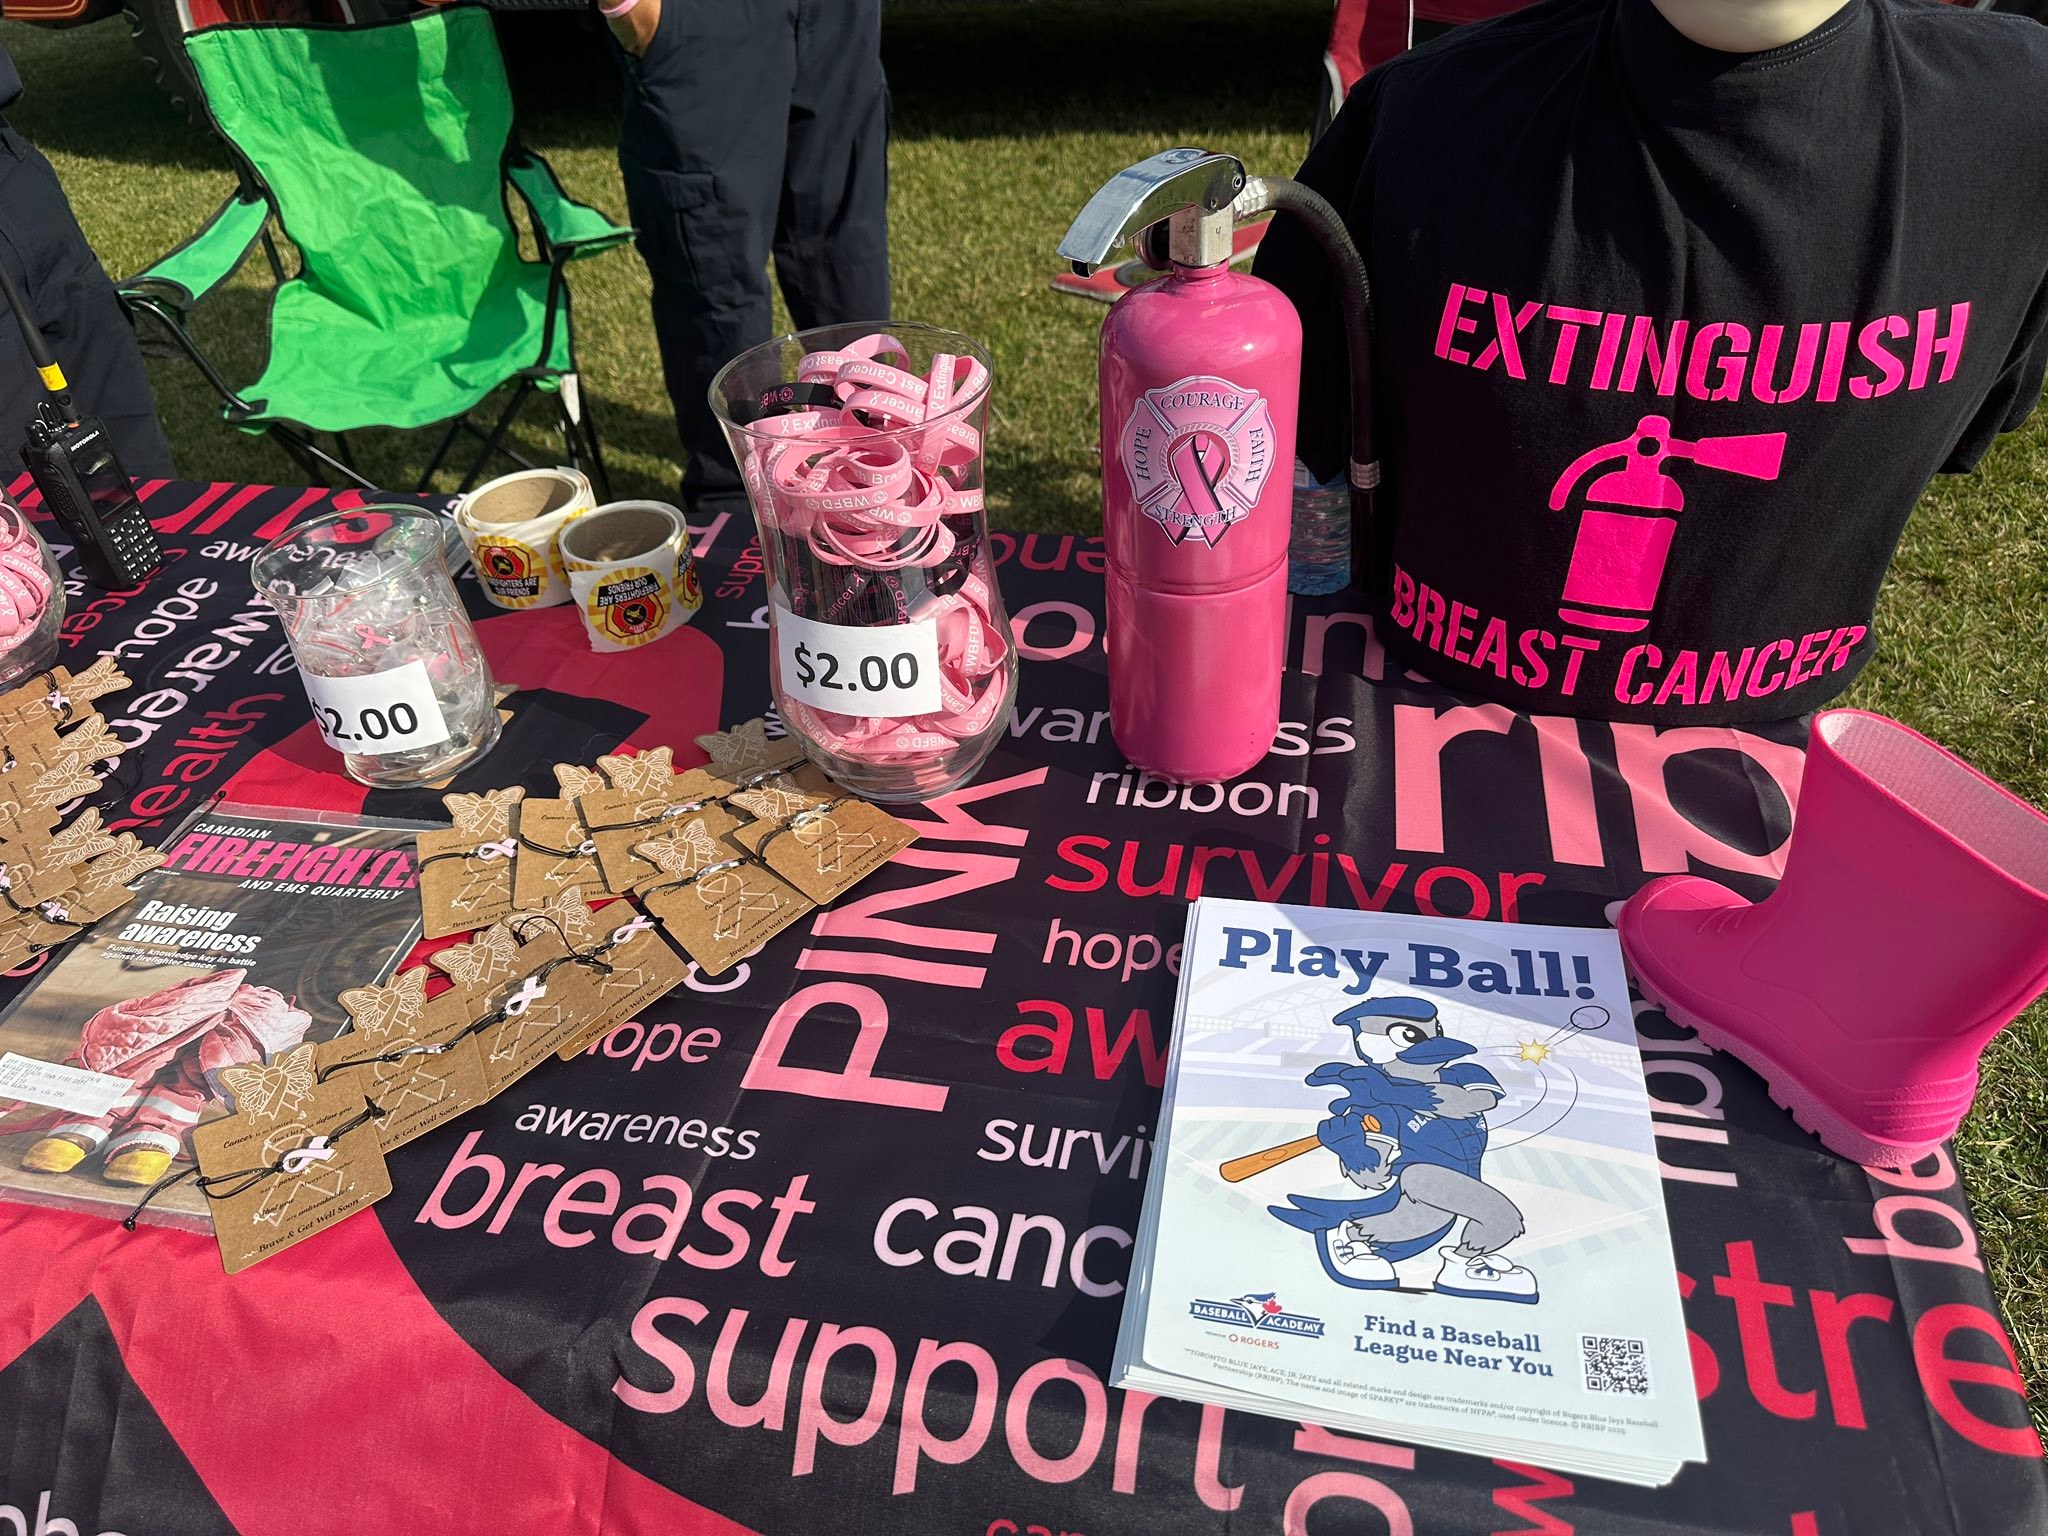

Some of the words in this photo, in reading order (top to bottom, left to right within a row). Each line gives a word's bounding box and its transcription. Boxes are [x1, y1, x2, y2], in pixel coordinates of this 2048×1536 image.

[1433, 282, 1971, 403] EXTINGUISH
[1161, 392, 1244, 411] COURAGE
[71, 430, 100, 452] MOTOROLA
[1133, 425, 1152, 484] HOPE
[1245, 426, 1266, 486] FAITH
[823, 494, 869, 510] WBFD
[1154, 504, 1237, 528] STRENGTH
[507, 587, 530, 597] FRIENDS
[524, 577, 538, 587] ARE
[599, 595, 613, 606] ARE
[607, 580, 634, 595] FRIENDS
[614, 581, 659, 603] FIREFIGHTERS
[633, 576, 648, 588] OUR
[966, 622, 983, 668] WBFD
[1390, 562, 1602, 696] BREAST
[1614, 624, 1867, 705] CANCER
[794, 641, 920, 693] $2.00
[312, 697, 418, 740] $2.00
[1086, 765, 1320, 819] ribbon
[192, 823, 272, 839] CANADIAN
[237, 879, 274, 891] AND
[277, 883, 310, 895] EMS
[312, 885, 404, 900] QUARTERLY
[1044, 834, 1546, 922] survivor
[135, 900, 238, 931] Raising
[769, 918, 784, 931] Well
[784, 907, 800, 920] Soon
[107, 944, 145, 955] Funding,
[149, 949, 198, 961] knowledge
[199, 954, 216, 963] key
[218, 956, 228, 964] in
[229, 958, 257, 967] battle
[118, 923, 262, 955] awareness
[741, 766, 1050, 1114] PINK
[101, 952, 134, 961] against
[136, 953, 183, 966] firefighter
[184, 962, 217, 970] cancer
[1218, 926, 1389, 996] Play
[1408, 943, 1596, 1000] Ball!
[585, 1025, 607, 1041] Brave
[615, 1008, 629, 1020] Get
[630, 996, 646, 1010] Well
[647, 984, 664, 998] Soon
[530, 1048, 544, 1060] Get
[545, 1035, 562, 1049] Well
[563, 1022, 580, 1036] Soon
[587, 1020, 721, 1071] ope
[402, 1124, 418, 1138] Get
[419, 1113, 437, 1128] Well
[439, 1104, 459, 1118] Soon
[515, 1103, 761, 1161] awareness
[223, 1134, 254, 1149] Cancer
[977, 1118, 1155, 1181] survi
[415, 1130, 816, 1279] breast
[258, 1236, 285, 1253] Brave
[287, 1230, 295, 1240] &
[297, 1221, 314, 1234] Get
[316, 1209, 336, 1225] Well
[337, 1198, 360, 1214] Soon
[874, 1196, 1133, 1299] canc
[1193, 1304, 1248, 1323] BASEBALL
[1266, 1316, 1321, 1334] ACADEMY
[1364, 1314, 1417, 1338] Find
[1422, 1326, 1435, 1340] a
[1440, 1325, 1541, 1353] Baseball
[1240, 1336, 1280, 1350] ROGERS
[1354, 1336, 1438, 1364] League
[1443, 1347, 1503, 1371] Near
[1504, 1355, 1554, 1377] You
[1213, 1362, 1253, 1377] Partnership
[1286, 1378, 1299, 1387] The
[1301, 1382, 1320, 1391] name
[1322, 1385, 1335, 1394] and
[1336, 1388, 1359, 1399] image
[1418, 1401, 1460, 1413] trademarks
[1499, 1411, 1516, 1421] used
[1517, 1414, 1540, 1424] under
[1228, 1357, 1248, 1369] BLUE
[1299, 1373, 1317, 1383] JAYS
[1318, 1376, 1332, 1386] and
[1343, 1381, 1368, 1391] related
[1369, 1385, 1391, 1395] marks
[1393, 1388, 1407, 1397] and
[1408, 1391, 1432, 1401] design
[1446, 1396, 1488, 1408] trademarks
[1490, 1402, 1514, 1411] and/or
[1516, 1406, 1551, 1417] copyright
[1562, 1411, 1588, 1421] Rogers
[1589, 1414, 1607, 1423] Blue
[1608, 1416, 1624, 1426] Jays
[1626, 1418, 1658, 1428] Baseball
